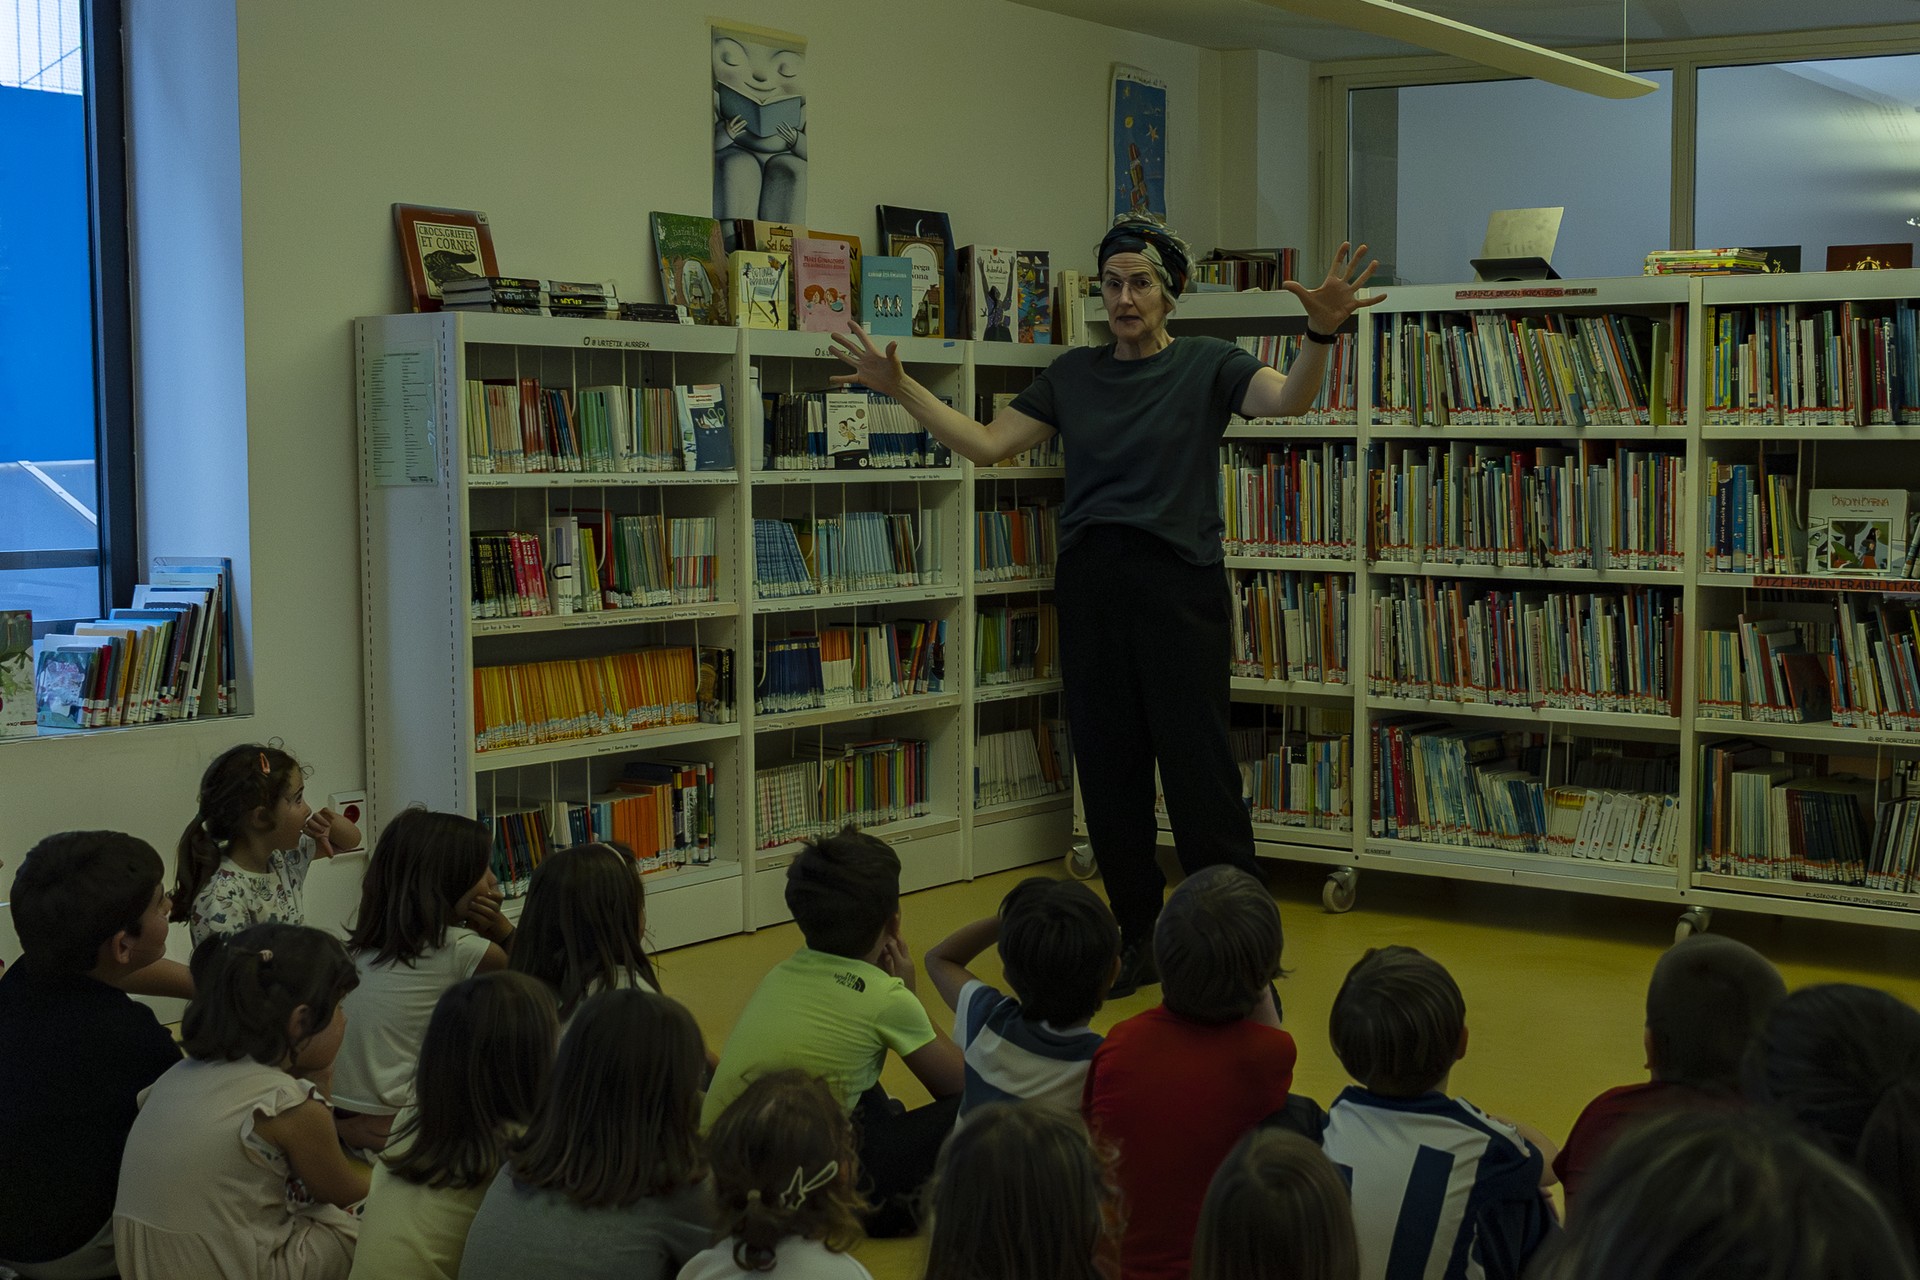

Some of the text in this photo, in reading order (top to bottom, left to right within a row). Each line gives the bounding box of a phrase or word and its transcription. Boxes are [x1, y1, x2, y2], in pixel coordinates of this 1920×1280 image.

[420, 235, 476, 252] ET CORNES
[1757, 577, 1786, 587] UTZI
[1790, 578, 1836, 590] HEMEN
